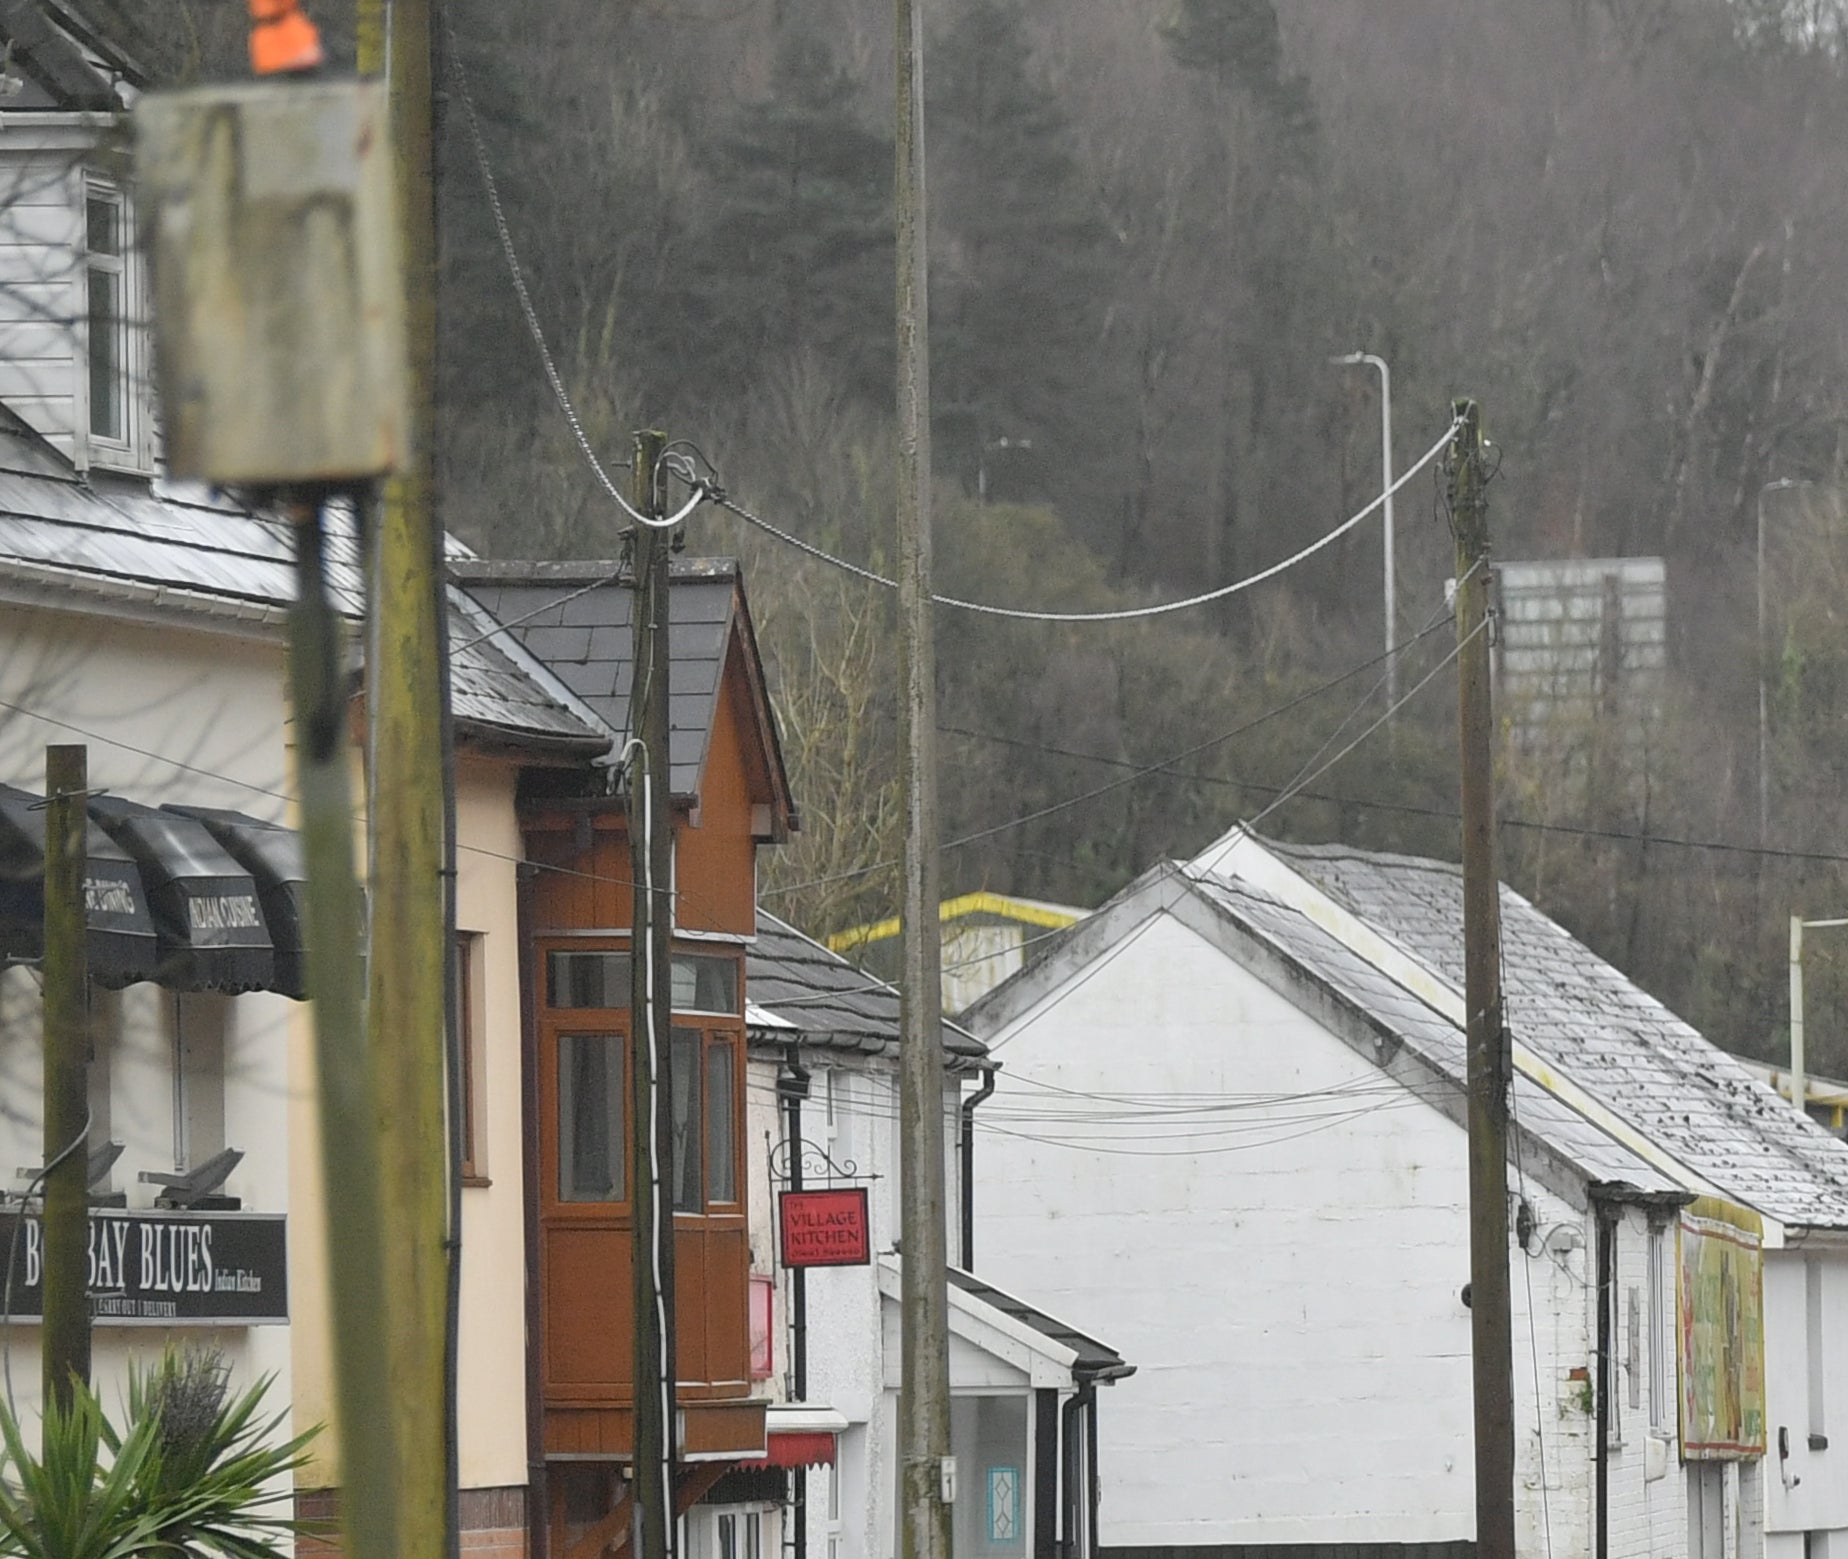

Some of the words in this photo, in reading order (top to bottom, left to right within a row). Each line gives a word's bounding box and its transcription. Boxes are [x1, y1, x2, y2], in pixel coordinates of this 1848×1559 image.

[188, 896, 225, 929] INDIAN
[221, 896, 260, 928] CUISINE
[790, 1211, 857, 1227] VILLAGE
[791, 1229, 859, 1246] KITCHEN
[24, 1218, 131, 1288] BBAY
[139, 1222, 213, 1293] BLUES
[215, 1268, 236, 1292] Indian
[236, 1269, 262, 1293] Kitchen
[121, 1299, 136, 1315] OUT
[143, 1300, 177, 1317] DELIVERY
